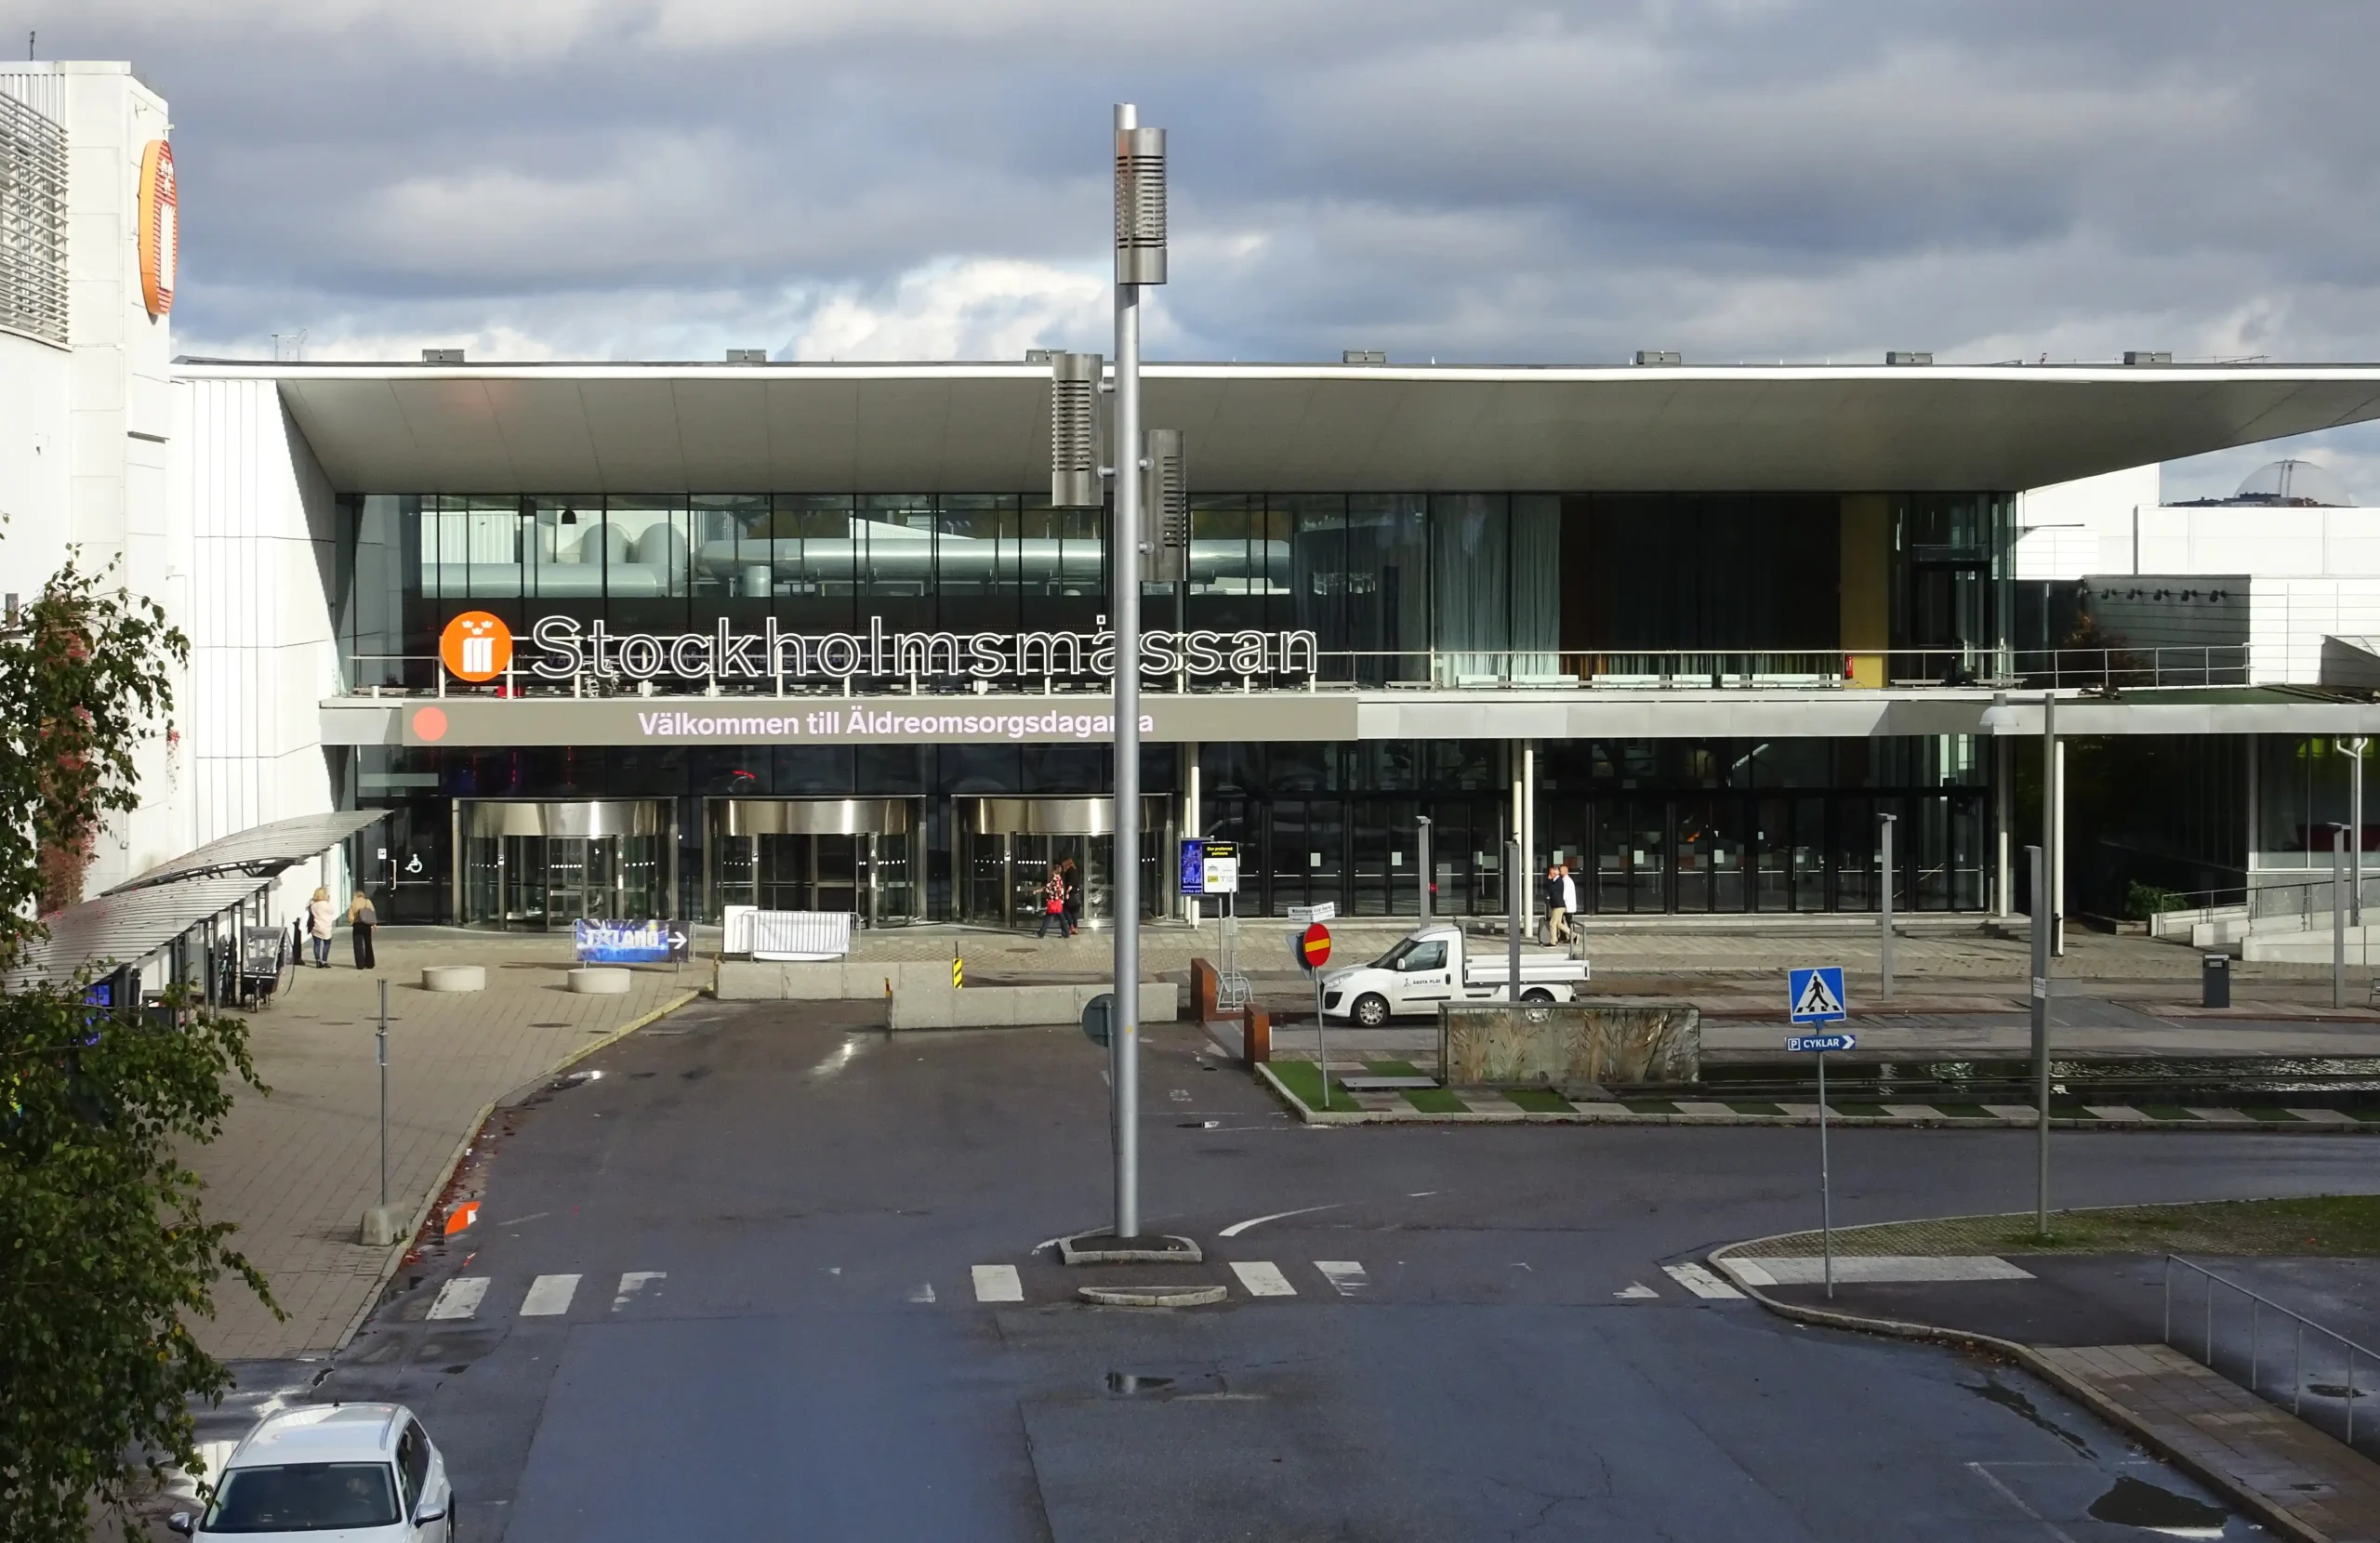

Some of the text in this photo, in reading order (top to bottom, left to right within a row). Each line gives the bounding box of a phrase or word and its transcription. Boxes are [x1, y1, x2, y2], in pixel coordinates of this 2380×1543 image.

[531, 614, 1317, 679] Stockholmsmässan
[639, 706, 1154, 737] Välkommen till Äldreomsorgsdagara
[1803, 1038, 1840, 1048] CYKLAR
